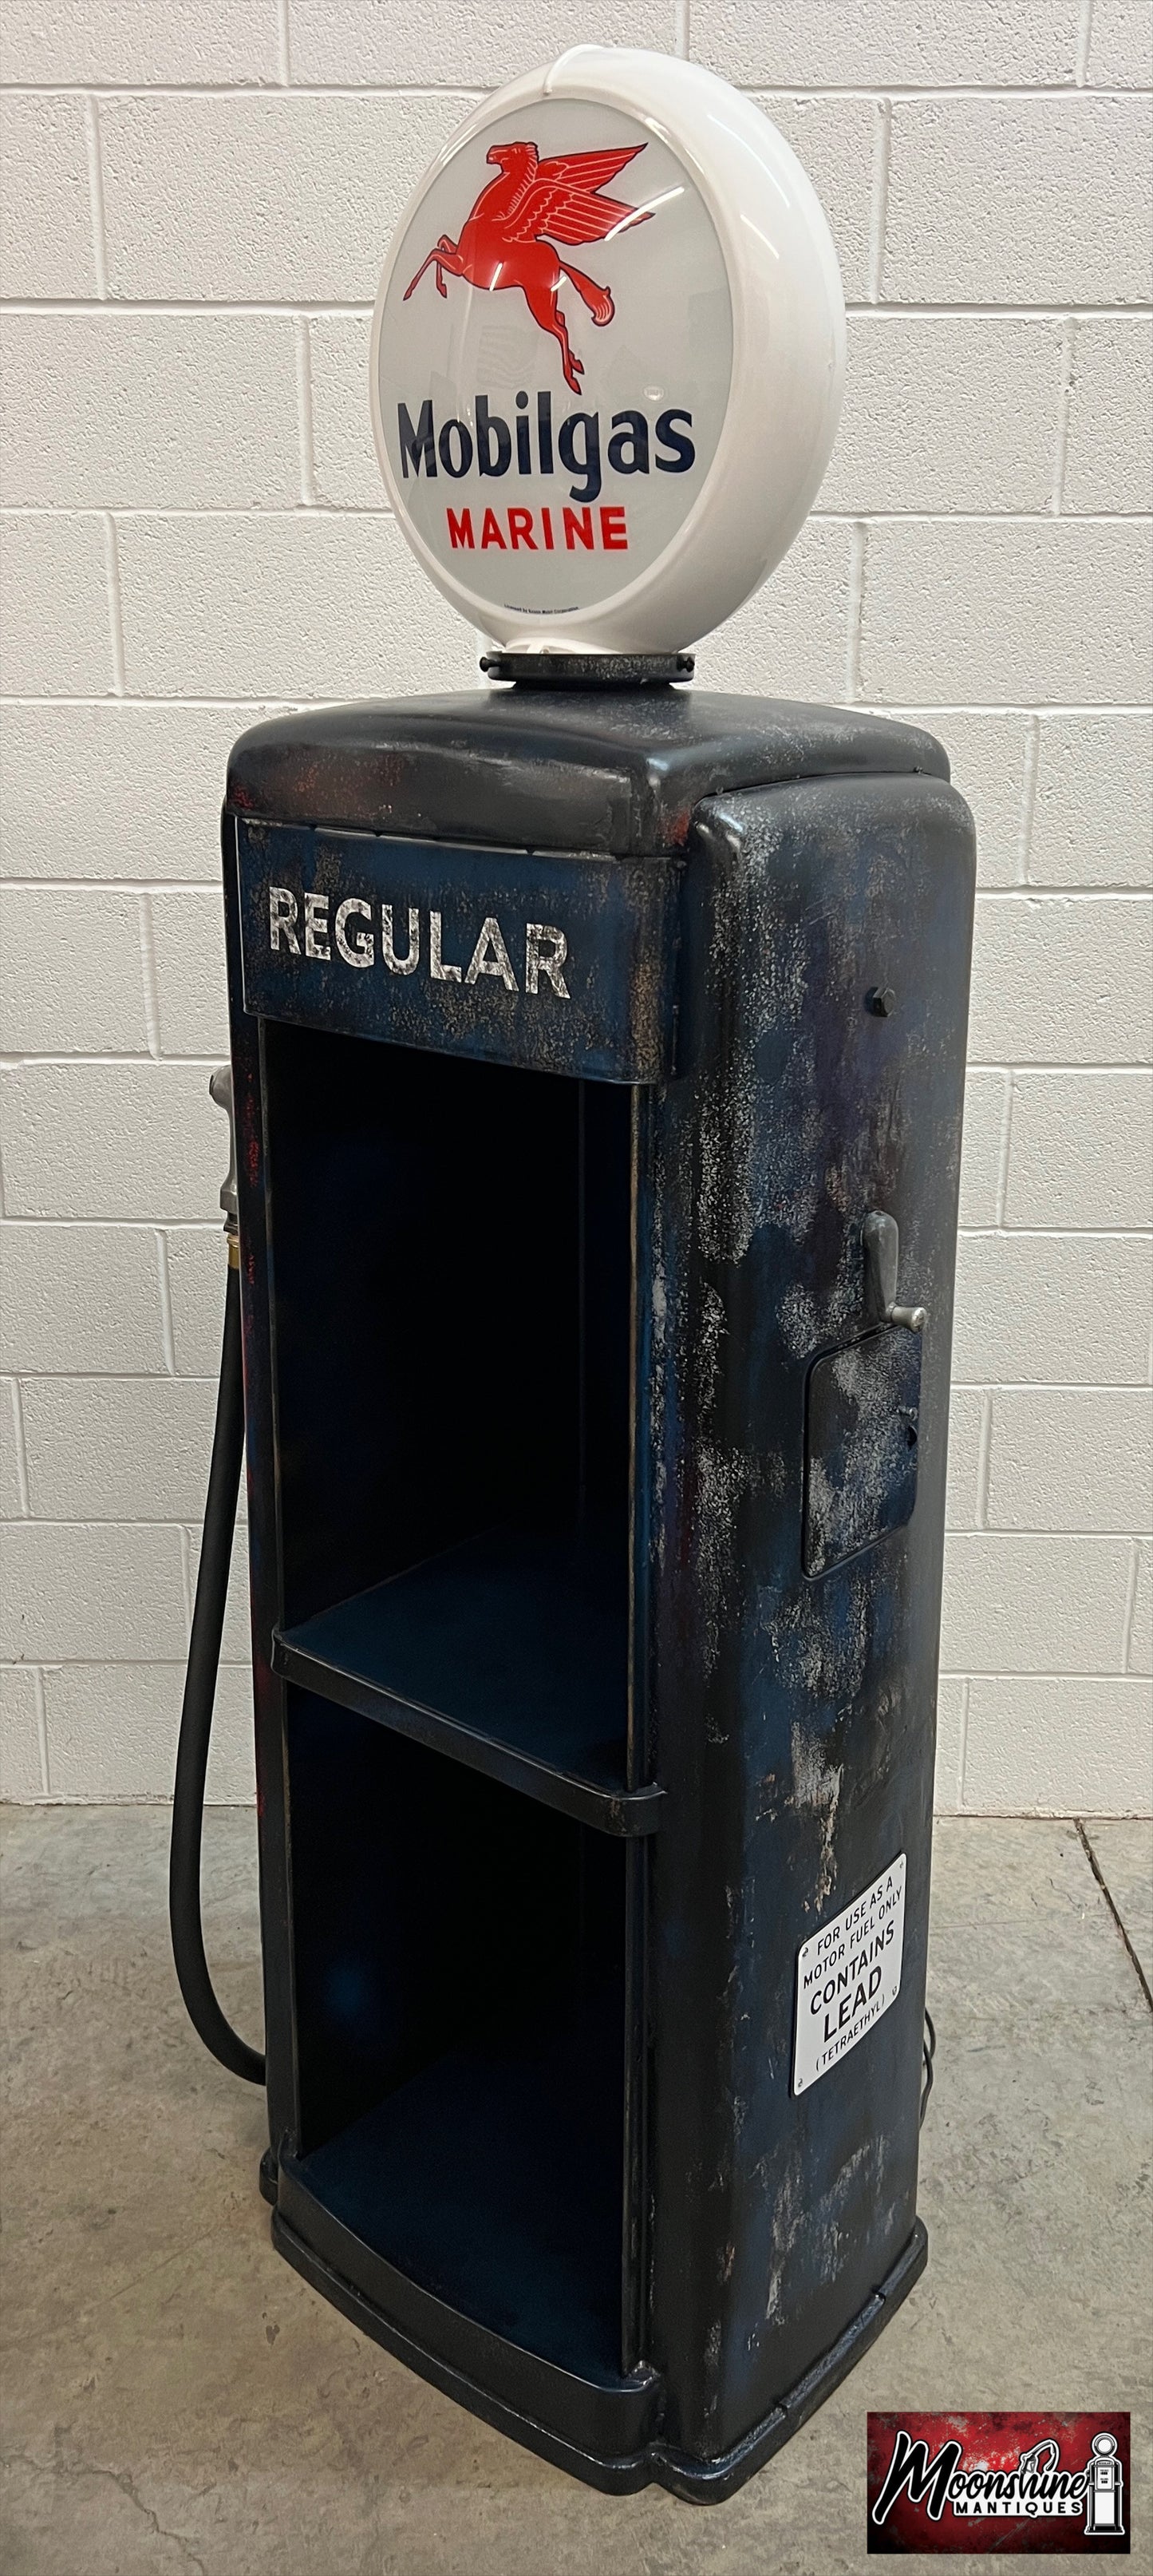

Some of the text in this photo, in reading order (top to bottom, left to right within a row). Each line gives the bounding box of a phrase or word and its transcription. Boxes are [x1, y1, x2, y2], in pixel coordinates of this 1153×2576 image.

[397, 391, 696, 503] Mobilgas
[446, 506, 628, 549] MARINE
[269, 886, 571, 999] REGULAR
[804, 1886, 902, 1989] MOTOR FUEL ONLY
[817, 1876, 893, 1956] FOR USE AS A
[811, 1920, 894, 2016] CONTAINS
[823, 1965, 883, 2043] LEAD
